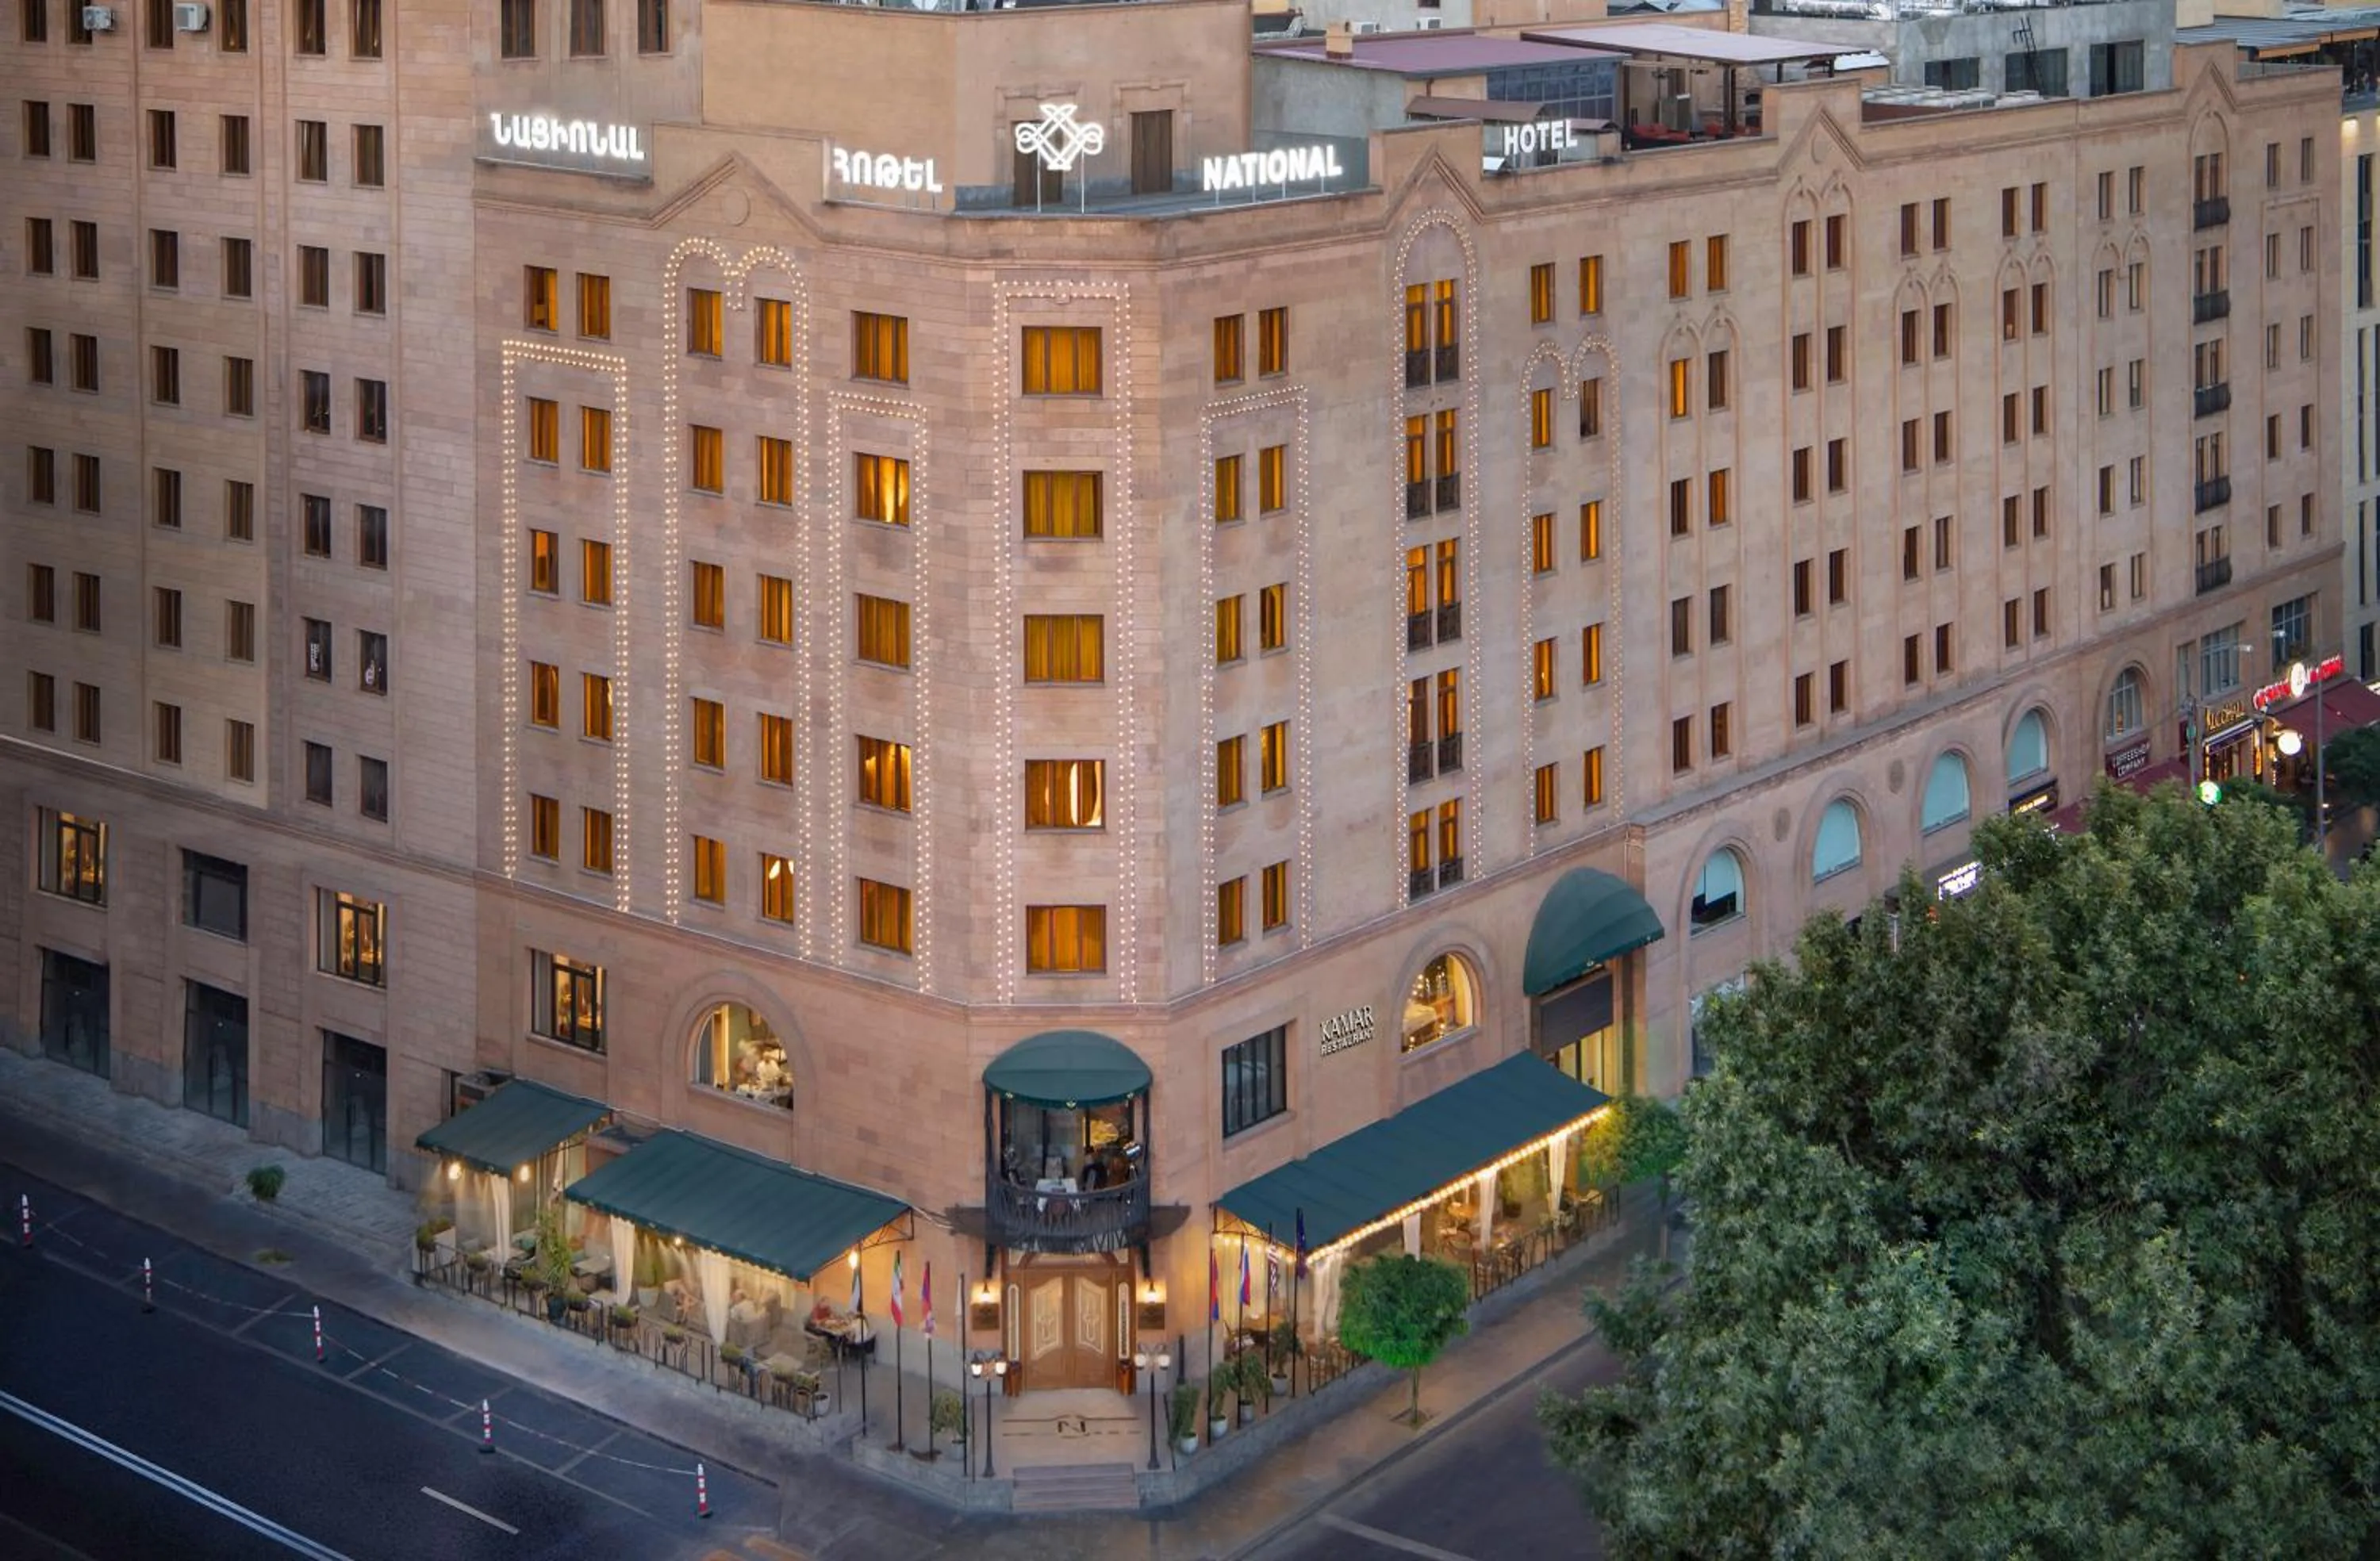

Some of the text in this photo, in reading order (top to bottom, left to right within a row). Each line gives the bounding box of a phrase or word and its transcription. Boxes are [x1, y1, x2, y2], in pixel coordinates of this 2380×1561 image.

[490, 113, 942, 193] ՆԱՑԻՈՆԱԼ ՀՈԹԵԼ
[1203, 119, 1577, 191] NATIONAL HOTEL
[1320, 1005, 1374, 1042] KAMAR
[1321, 1027, 1374, 1056] RESTAURANT
